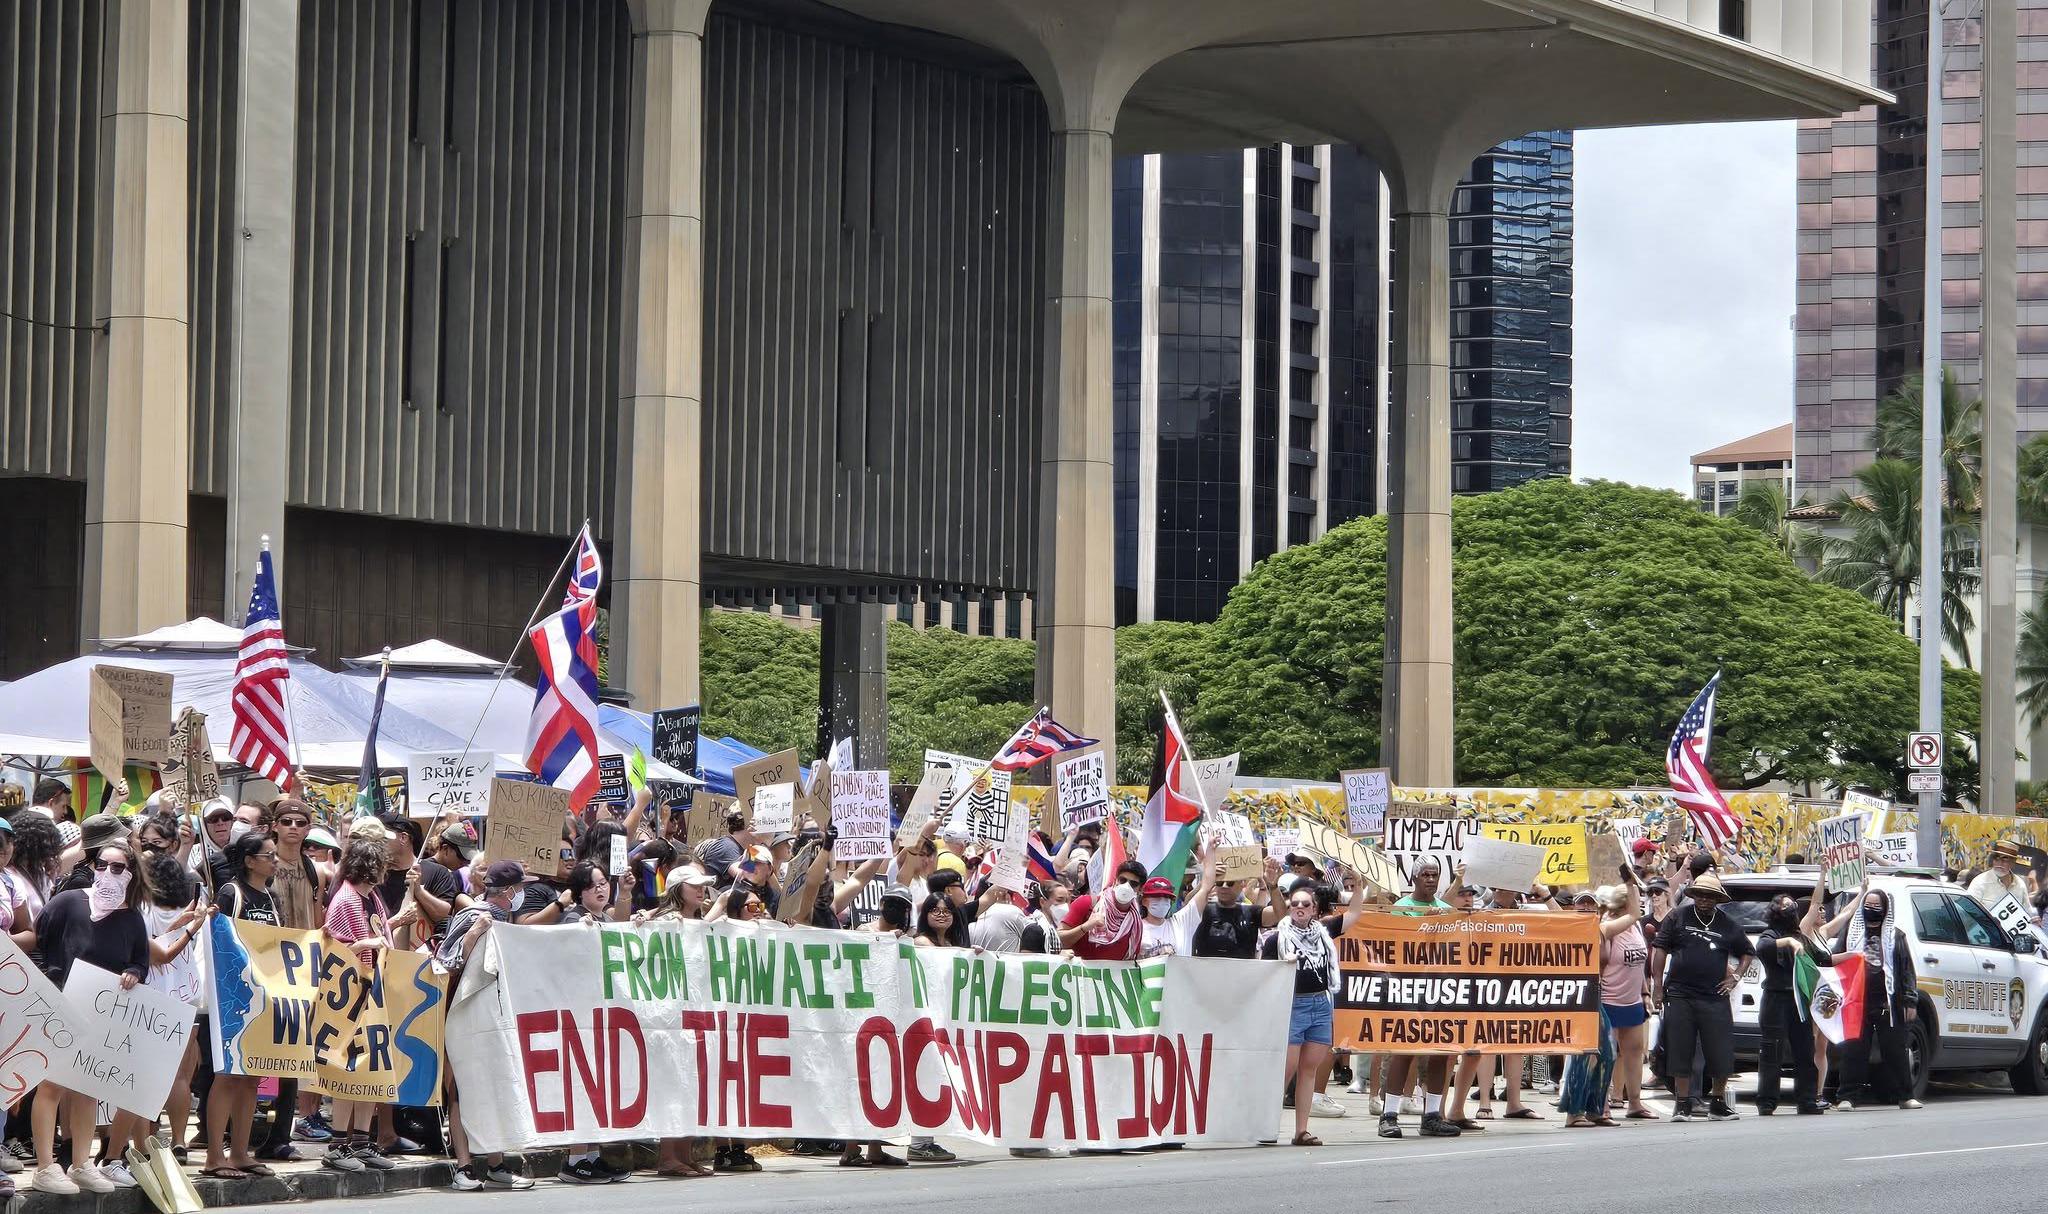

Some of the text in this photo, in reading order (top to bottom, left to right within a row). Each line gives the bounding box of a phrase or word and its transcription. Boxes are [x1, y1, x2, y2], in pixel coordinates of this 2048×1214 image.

[421, 766, 475, 781] BRAVE
[752, 764, 783, 787] STOP
[1348, 774, 1380, 788] ONLY
[428, 791, 473, 805] CAVE
[1347, 787, 1367, 802] WE
[1530, 829, 1573, 846] Vance
[1824, 816, 1861, 847] MOST
[534, 846, 553, 860] ICE
[1546, 852, 1576, 874] Cat
[1830, 861, 1863, 890] MAN
[1340, 937, 1593, 967] IN THE NAME OF HUMANITY
[599, 927, 690, 1003] FROM
[951, 956, 1167, 1029] PALESTINE
[1347, 976, 1588, 1007] WE REFUSE TO ACCEPT
[1944, 979, 2007, 1012] SHERIFF
[94, 989, 185, 1046] CHINGA
[104, 1029, 133, 1054] LA
[1358, 1017, 1572, 1045] A FASCIST AMERICA!
[72, 1050, 135, 1090] MIGRA
[246, 1056, 297, 1073] STUDENTS
[517, 1006, 1213, 1141] END THE OCCUPATION
[318, 1077, 331, 1089] IN
[331, 1080, 384, 1097] PALESTINE
